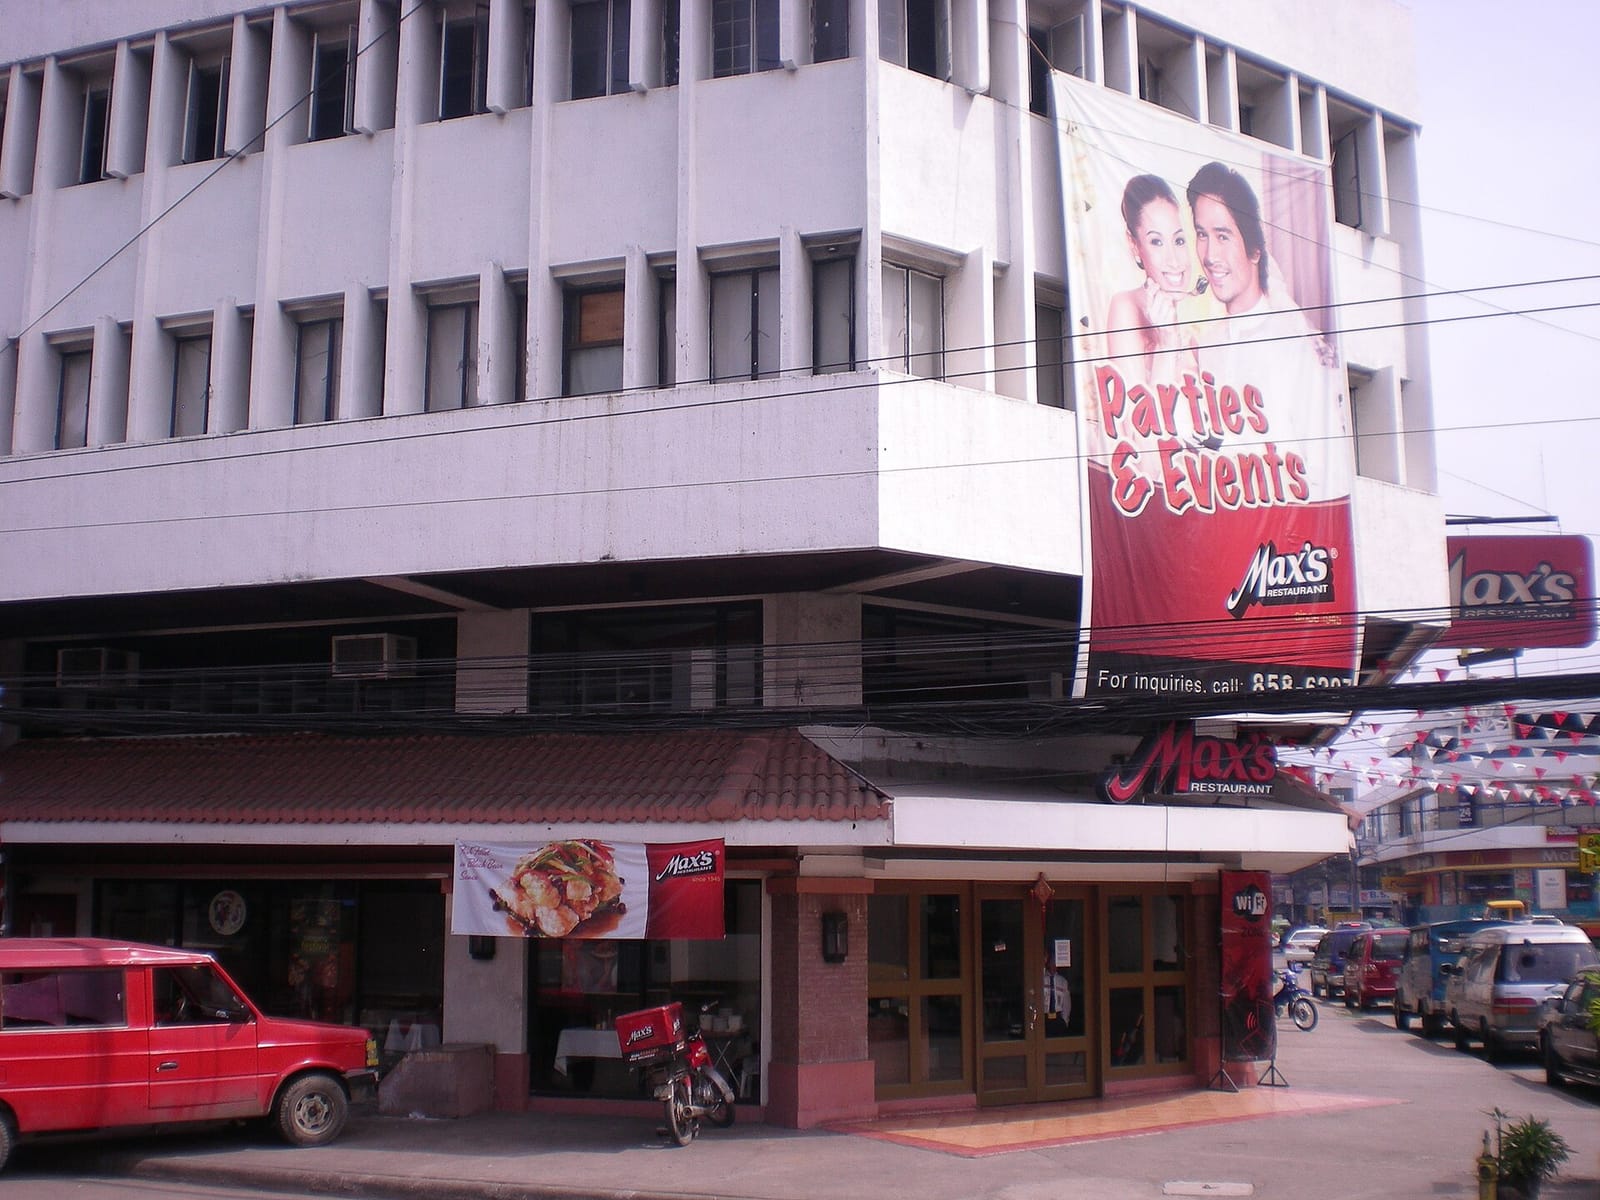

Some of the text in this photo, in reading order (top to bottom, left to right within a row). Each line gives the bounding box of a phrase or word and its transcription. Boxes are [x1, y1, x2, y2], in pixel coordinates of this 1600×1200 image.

[1095, 365, 1269, 438] Parties
[1112, 439, 1310, 513] & Events
[1227, 542, 1328, 610] Max's
[1266, 585, 1329, 598] RESTAURANT
[1098, 670, 1128, 688] For
[1108, 720, 1277, 801] Max's
[1191, 783, 1273, 795] RESTAURANT
[656, 851, 712, 880] Max's
[626, 1026, 652, 1046] Max's
